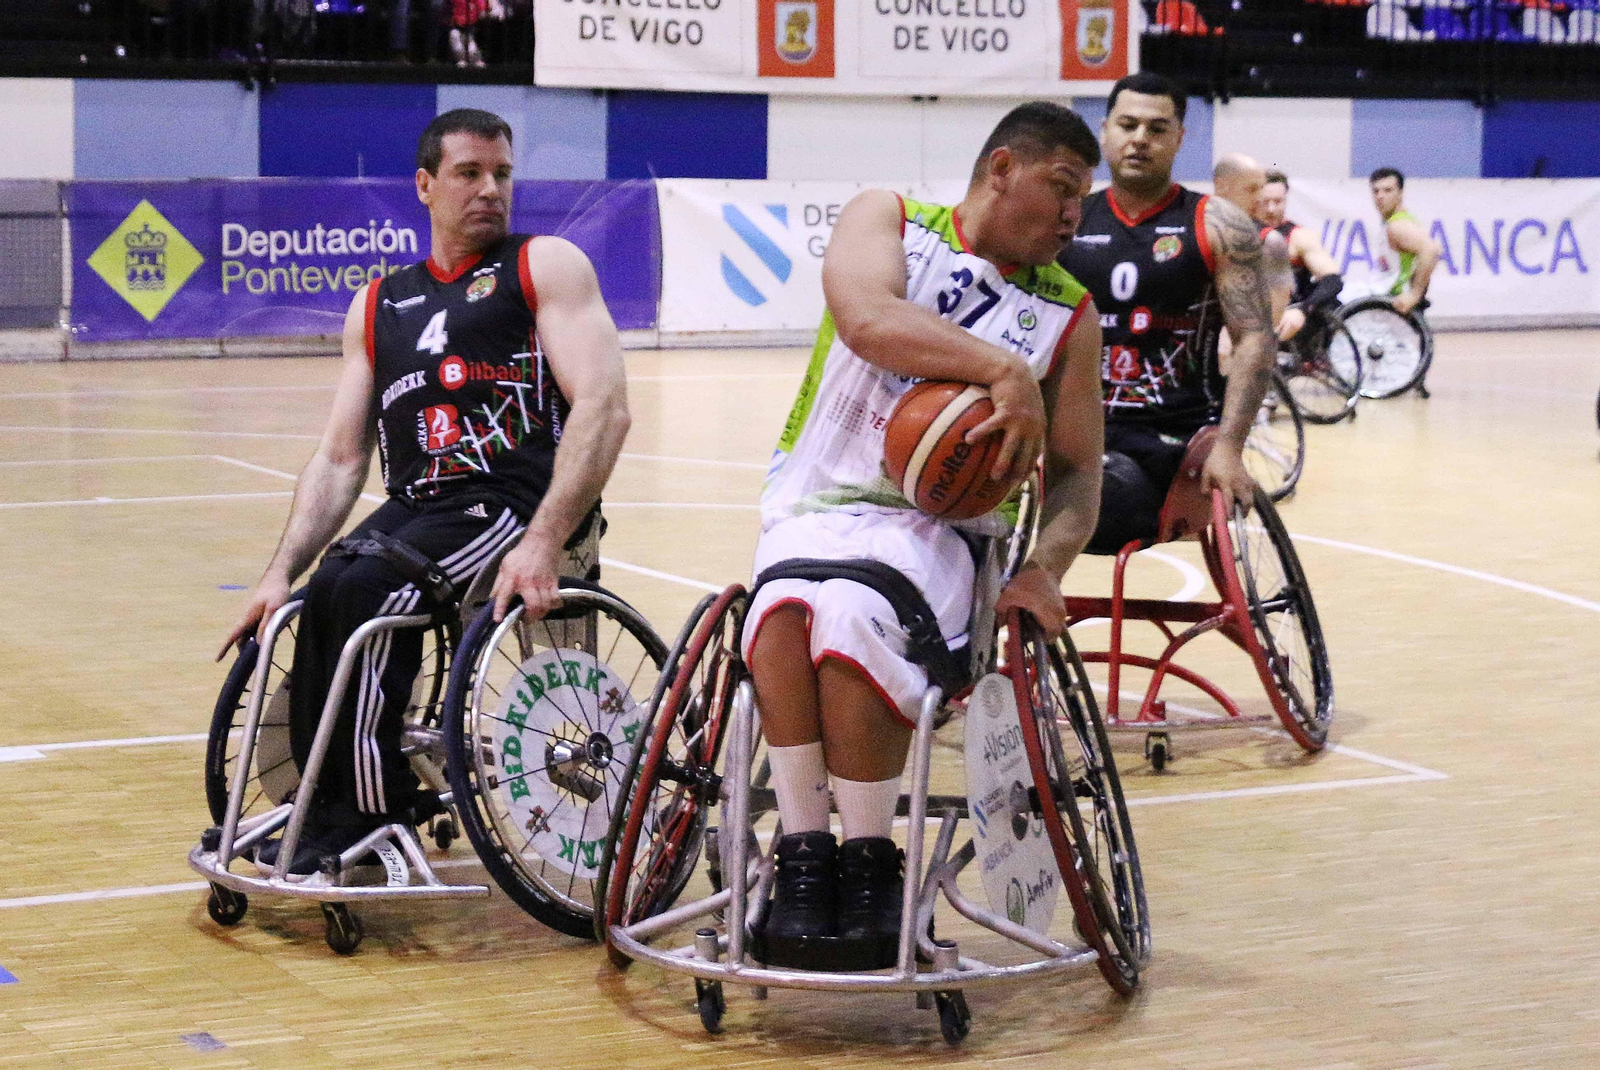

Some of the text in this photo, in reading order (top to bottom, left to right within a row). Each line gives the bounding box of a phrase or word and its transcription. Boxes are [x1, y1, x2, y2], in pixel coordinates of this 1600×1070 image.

[579, 15, 704, 46] DE VIGO
[894, 25, 1009, 52] DE VIGO
[221, 219, 418, 264] Deputación
[937, 267, 1003, 329] 37
[1111, 262, 1139, 301] 0
[416, 309, 448, 354] 4
[444, 361, 524, 383] Bilbao
